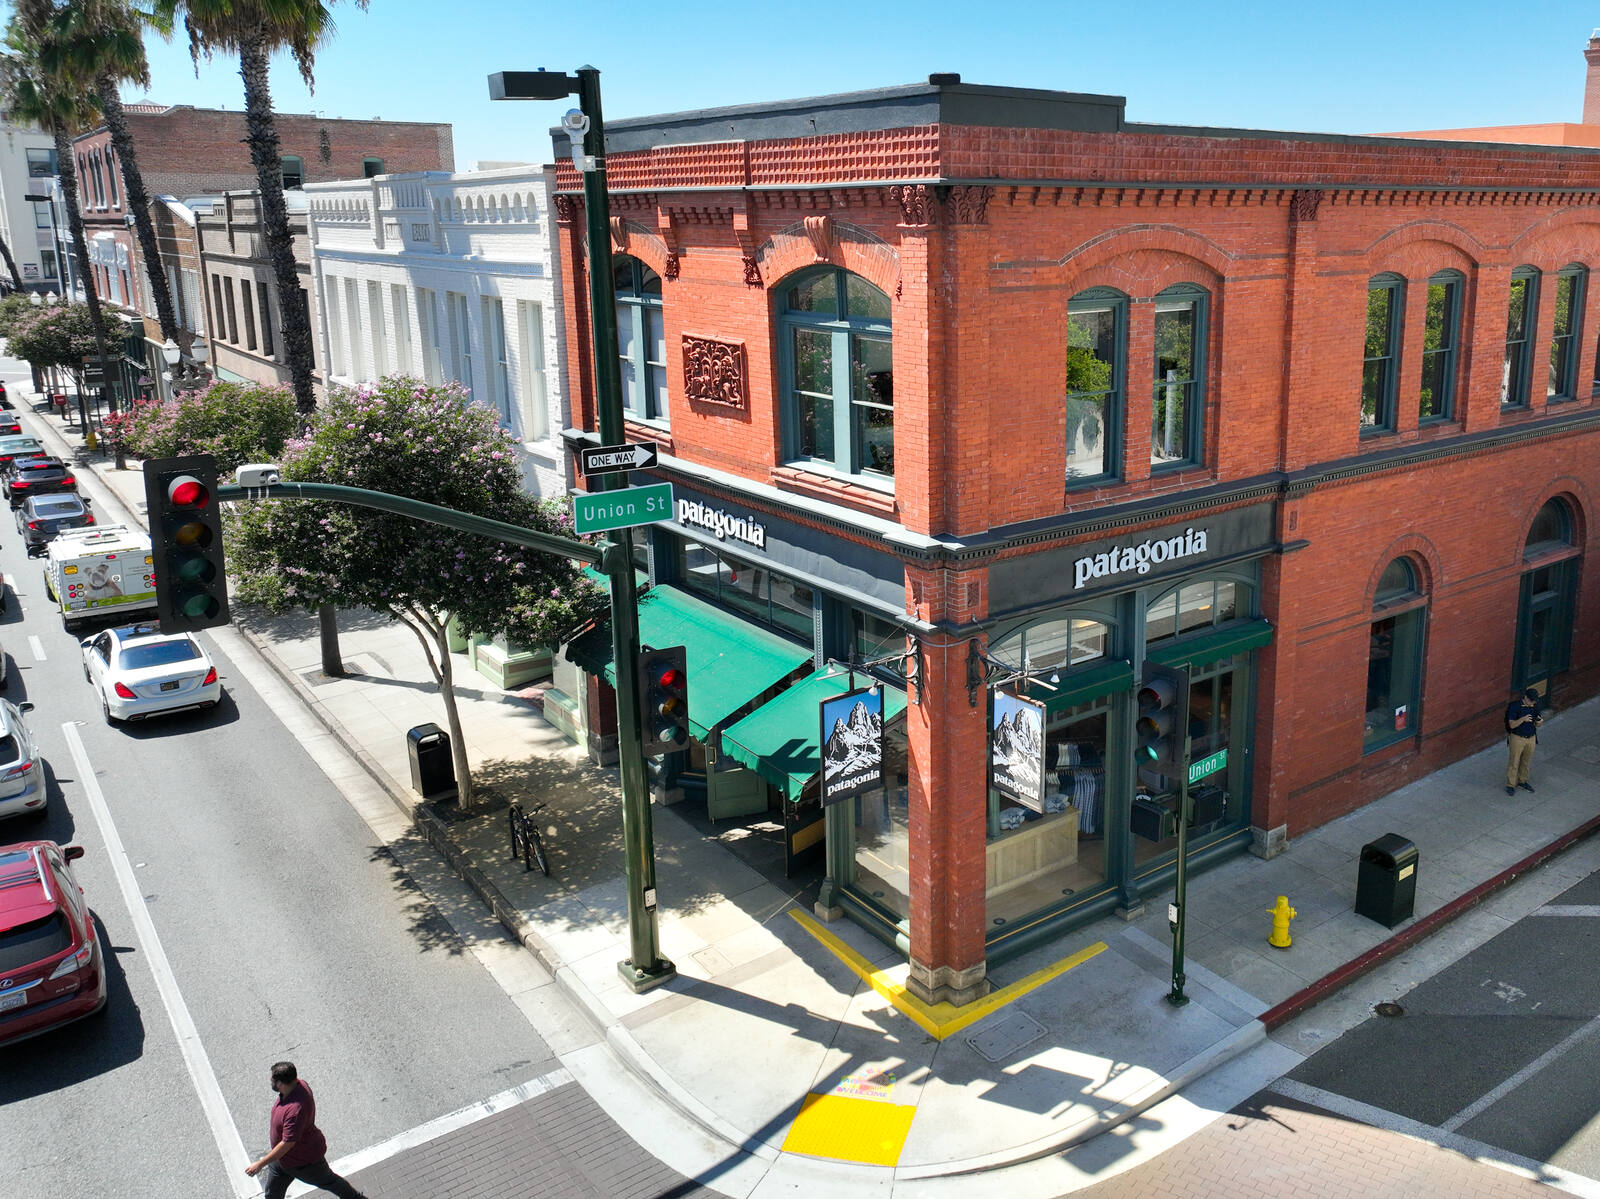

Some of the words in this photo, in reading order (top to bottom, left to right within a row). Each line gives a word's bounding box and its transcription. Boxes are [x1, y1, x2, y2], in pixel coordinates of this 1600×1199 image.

[591, 454, 611, 467] ONE
[615, 451, 635, 464] WAY
[584, 504, 635, 521] Union
[646, 496, 664, 512] St
[678, 498, 765, 548] patagonia
[1074, 527, 1208, 590] patagonia
[827, 769, 880, 797] patagonia
[1189, 758, 1217, 780] Union
[993, 772, 1039, 801] patagonia
